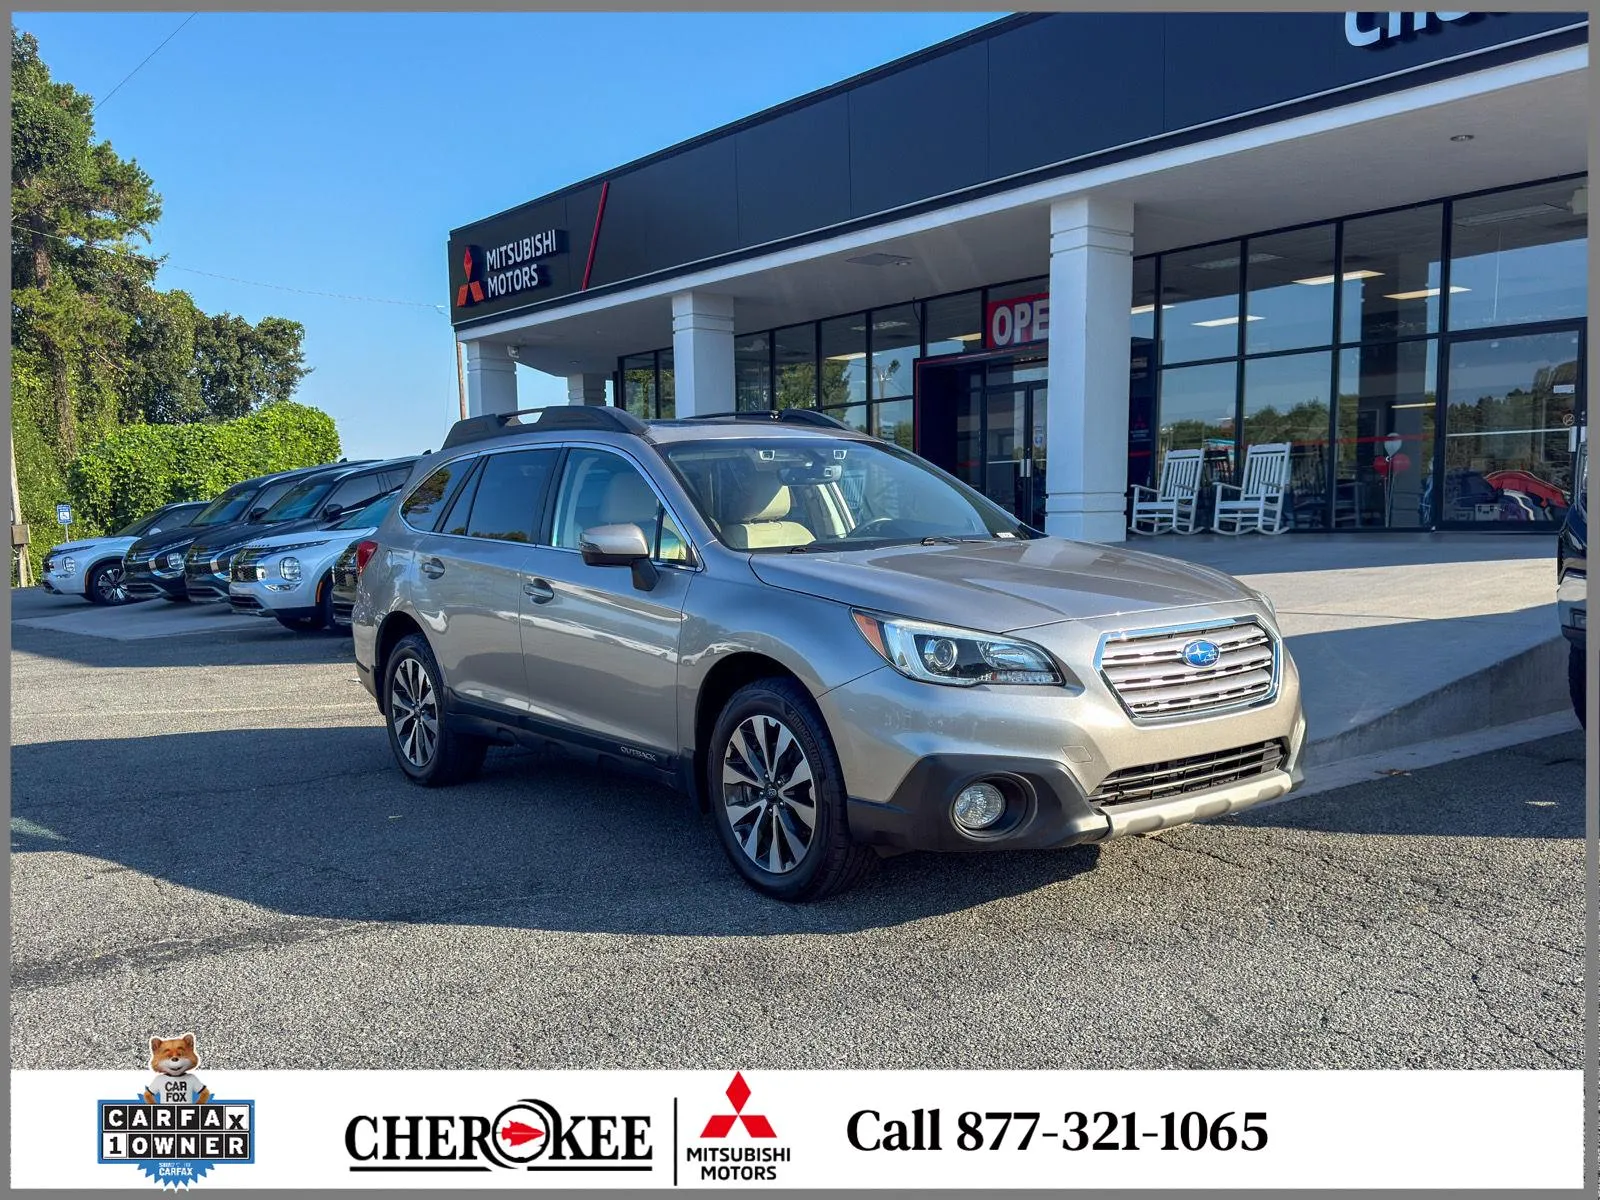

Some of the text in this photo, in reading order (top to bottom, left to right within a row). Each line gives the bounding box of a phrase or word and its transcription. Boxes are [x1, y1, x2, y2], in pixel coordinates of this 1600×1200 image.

[486, 229, 557, 272] MITSUBISHI
[487, 263, 539, 298] MOTORS
[992, 299, 1049, 346] OPE
